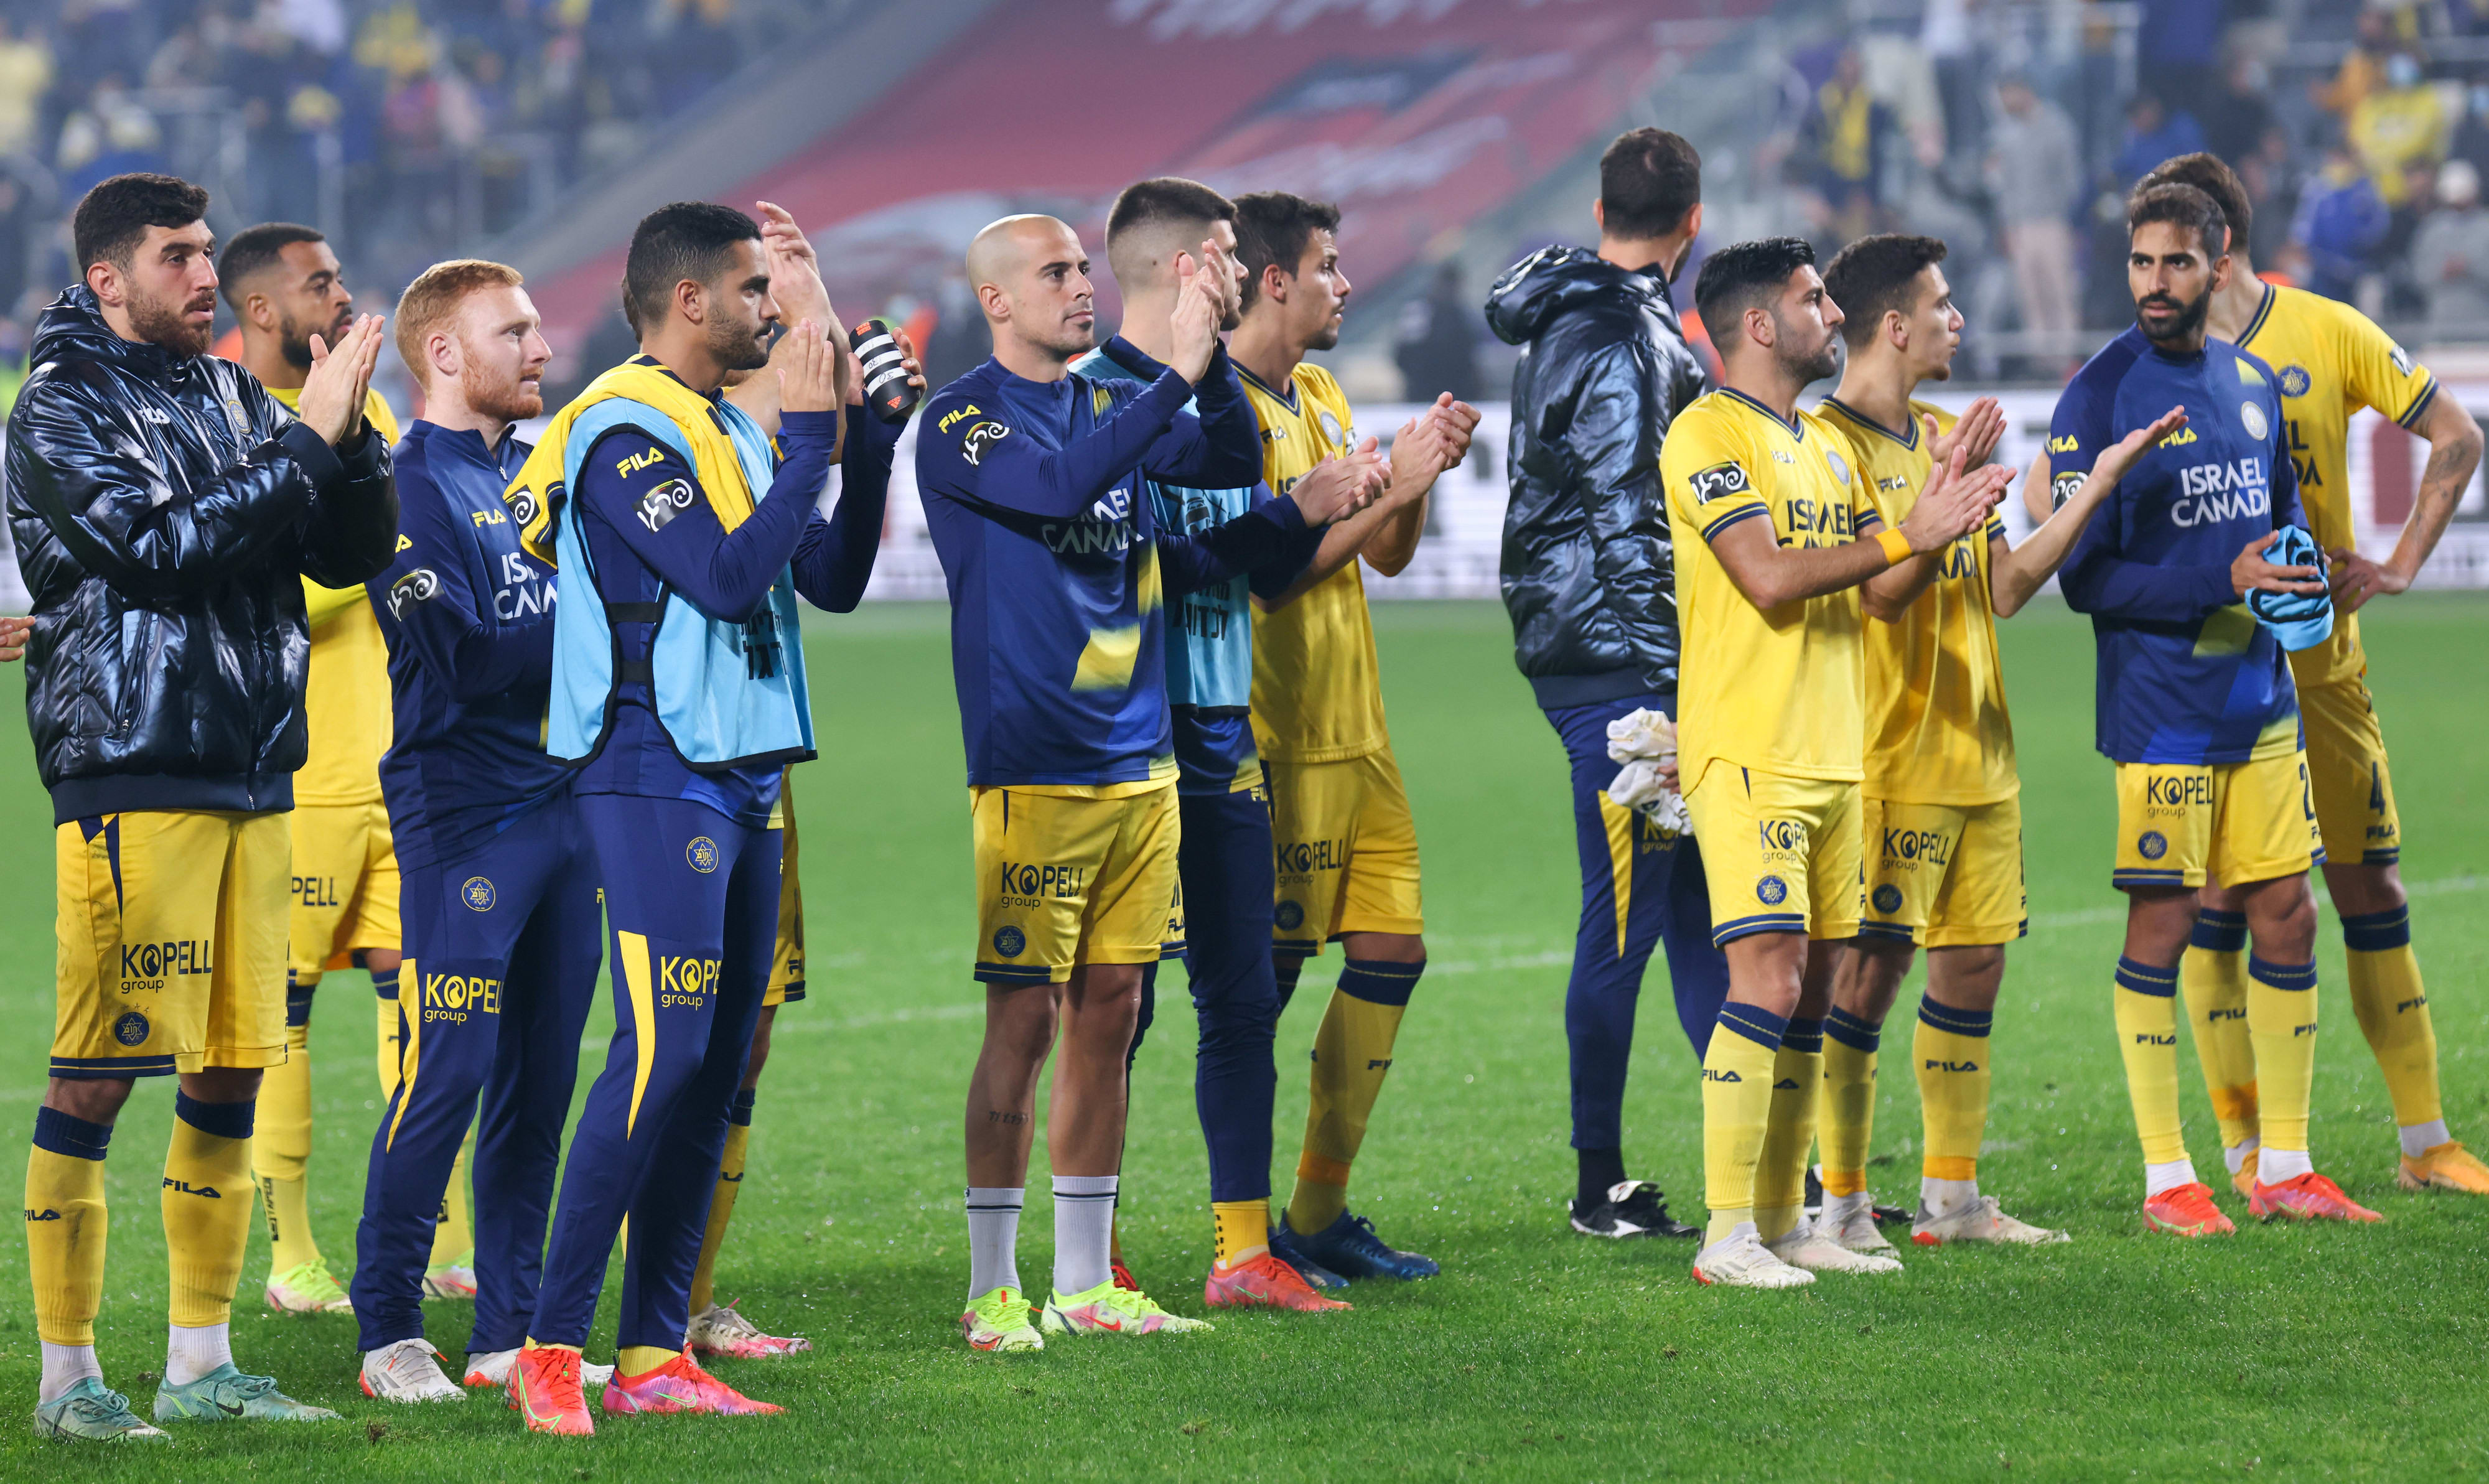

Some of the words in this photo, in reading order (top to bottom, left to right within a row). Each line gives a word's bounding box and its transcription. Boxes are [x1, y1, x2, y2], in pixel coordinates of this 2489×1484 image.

[938, 404, 981, 434] FILA
[616, 447, 665, 478] FILA
[1878, 474, 1907, 493] FILA
[2180, 457, 2266, 497] ISRAEL
[472, 508, 507, 528] FILA
[1787, 498, 1855, 536] ISRAEL
[2147, 776, 2213, 805] KOPEL
[2370, 762, 2386, 815] 4
[2147, 807, 2186, 819] group
[1277, 839, 1343, 873] KOPELL
[1883, 827, 1949, 865] KOPELL
[1762, 851, 1797, 864] group
[1882, 859, 1918, 874] group
[1001, 862, 1083, 898] KOPELL
[1279, 874, 1314, 887] group
[292, 876, 338, 906] PELL
[1001, 895, 1040, 910] group
[121, 940, 212, 978] KOPELL
[121, 979, 164, 994] group
[661, 994, 703, 1011] group
[424, 1009, 467, 1025] group
[2136, 1034, 2176, 1045] FILA
[1926, 1059, 1978, 1072] FILA
[162, 1177, 222, 1198] FILA
[25, 1210, 61, 1221] ILA
